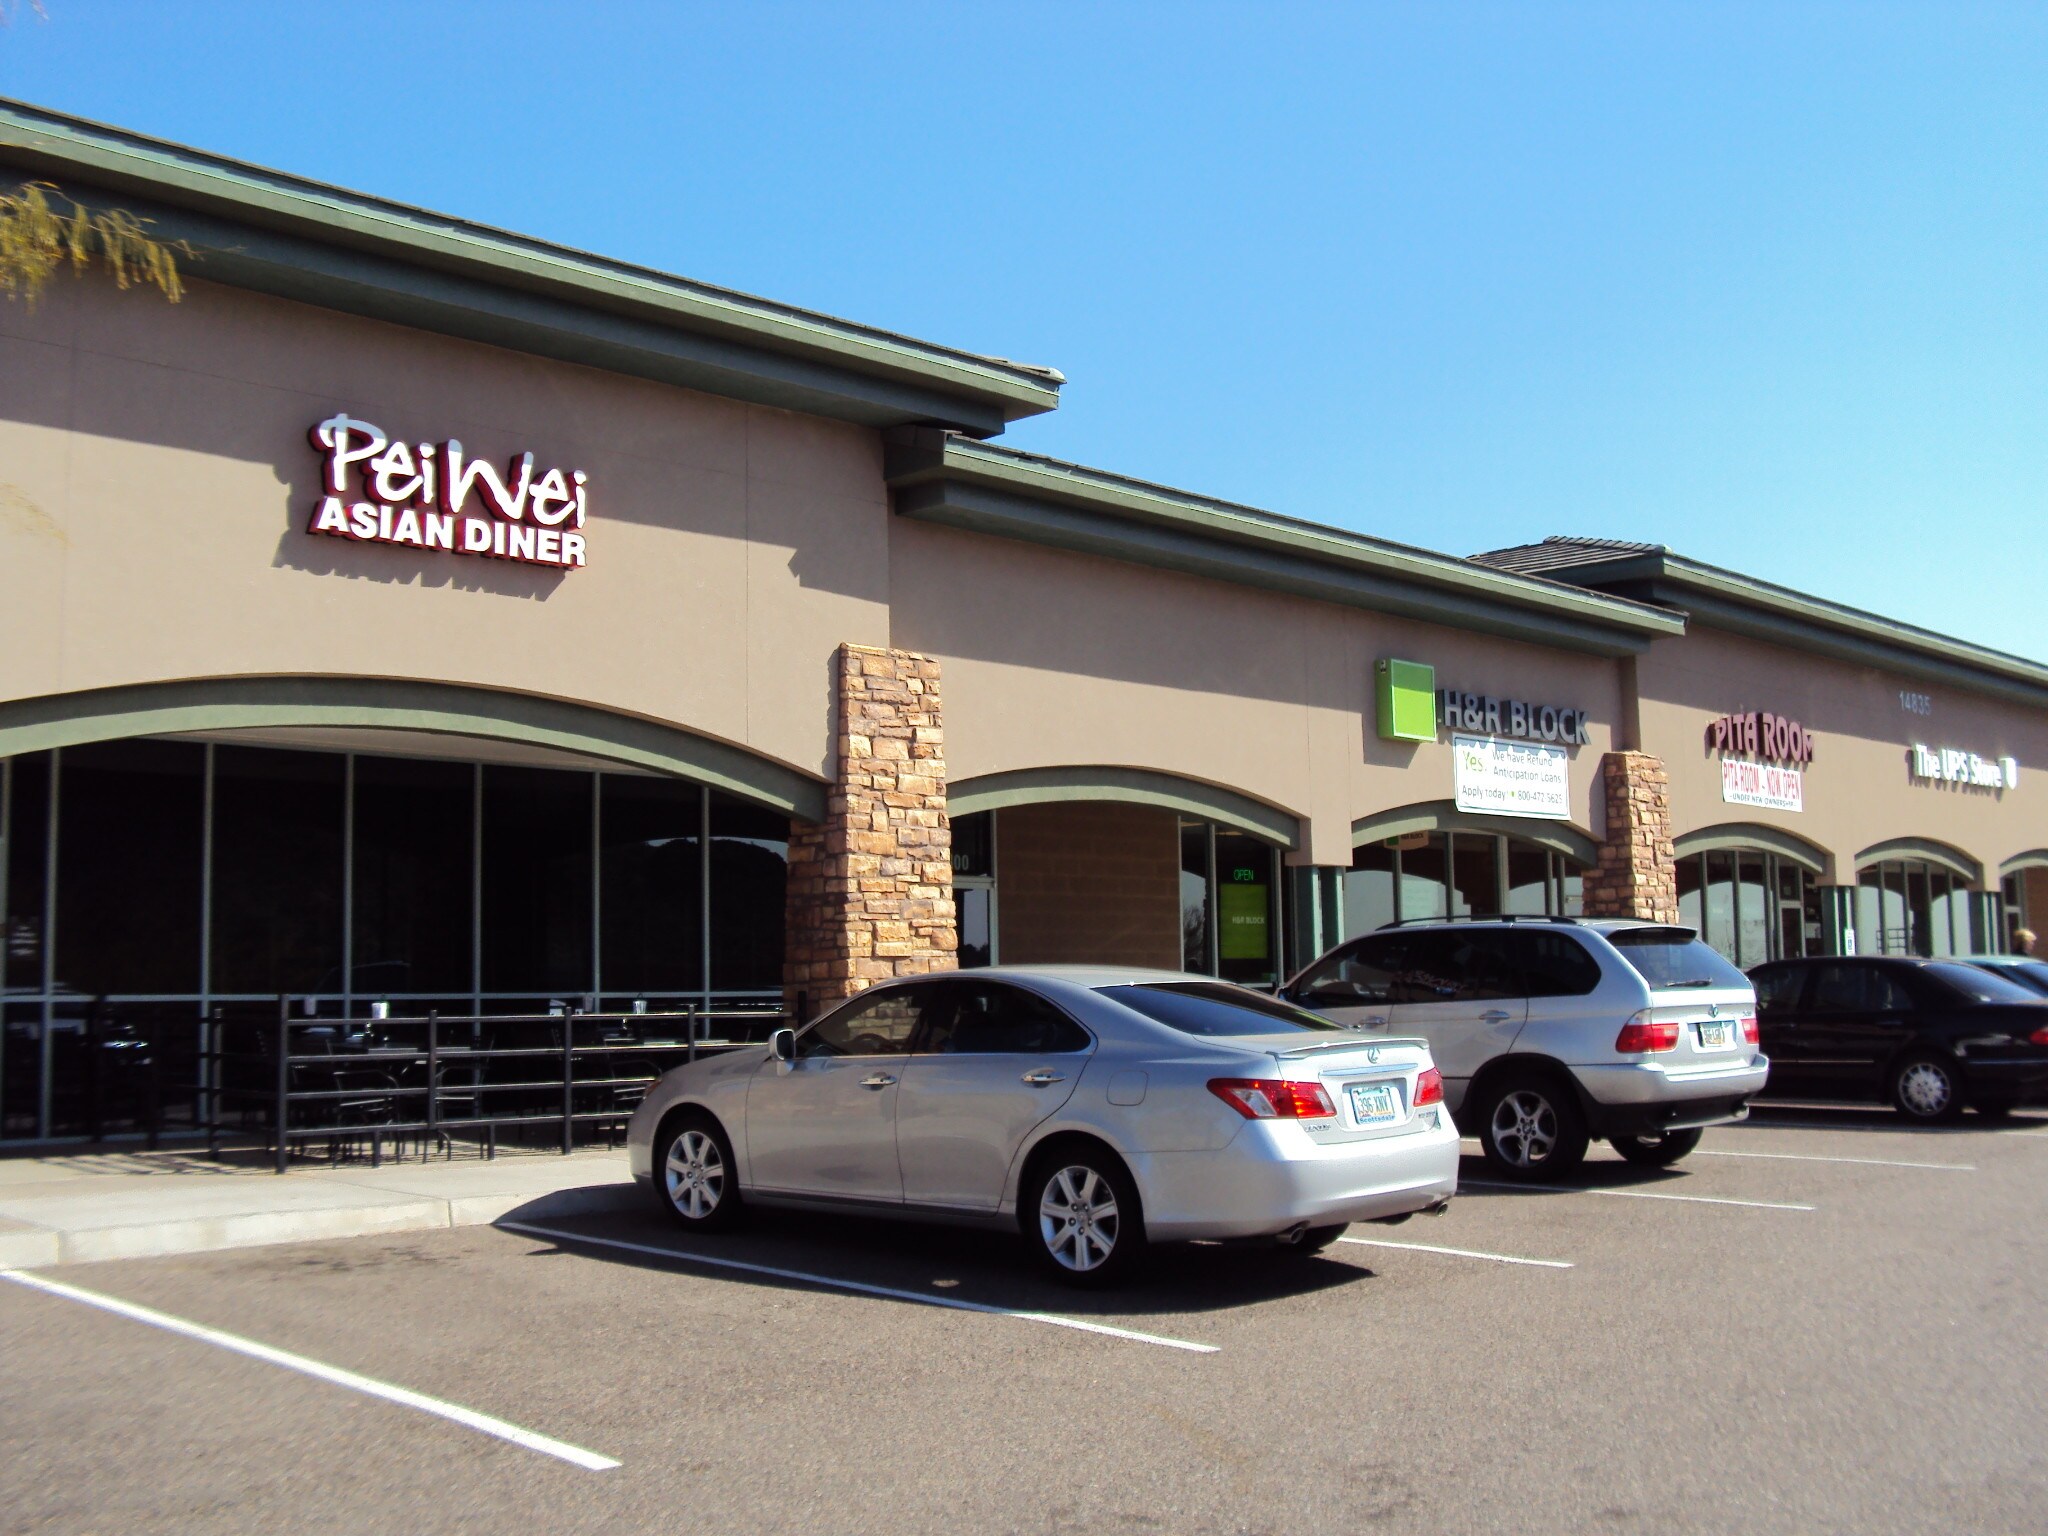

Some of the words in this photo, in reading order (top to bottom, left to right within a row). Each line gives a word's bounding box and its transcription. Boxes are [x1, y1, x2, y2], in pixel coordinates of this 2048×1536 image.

[315, 413, 434, 503] Pei
[446, 439, 587, 528] Wei
[314, 496, 454, 551] ASIAN
[463, 518, 587, 567] DINER
[1443, 688, 1503, 734] H&R
[1510, 701, 1592, 745] BLOCK
[1714, 712, 1757, 751] PITA
[1762, 712, 1813, 762] ROOM
[1492, 750, 1505, 762] We
[1506, 751, 1525, 764] have
[1526, 753, 1553, 767] Refund
[1493, 766, 1539, 781] Anticipation
[1541, 772, 1562, 784] Loans
[1915, 744, 1940, 779] The
[1941, 749, 1968, 783] UPS
[1462, 785, 1483, 799] Apply
[1723, 762, 1739, 791] PITA
[1739, 764, 1760, 794] ROOM
[1783, 771, 1800, 800] OPEN
[1233, 869, 1254, 881] OPEN
[1360, 1115, 1396, 1124] Scottsdale
